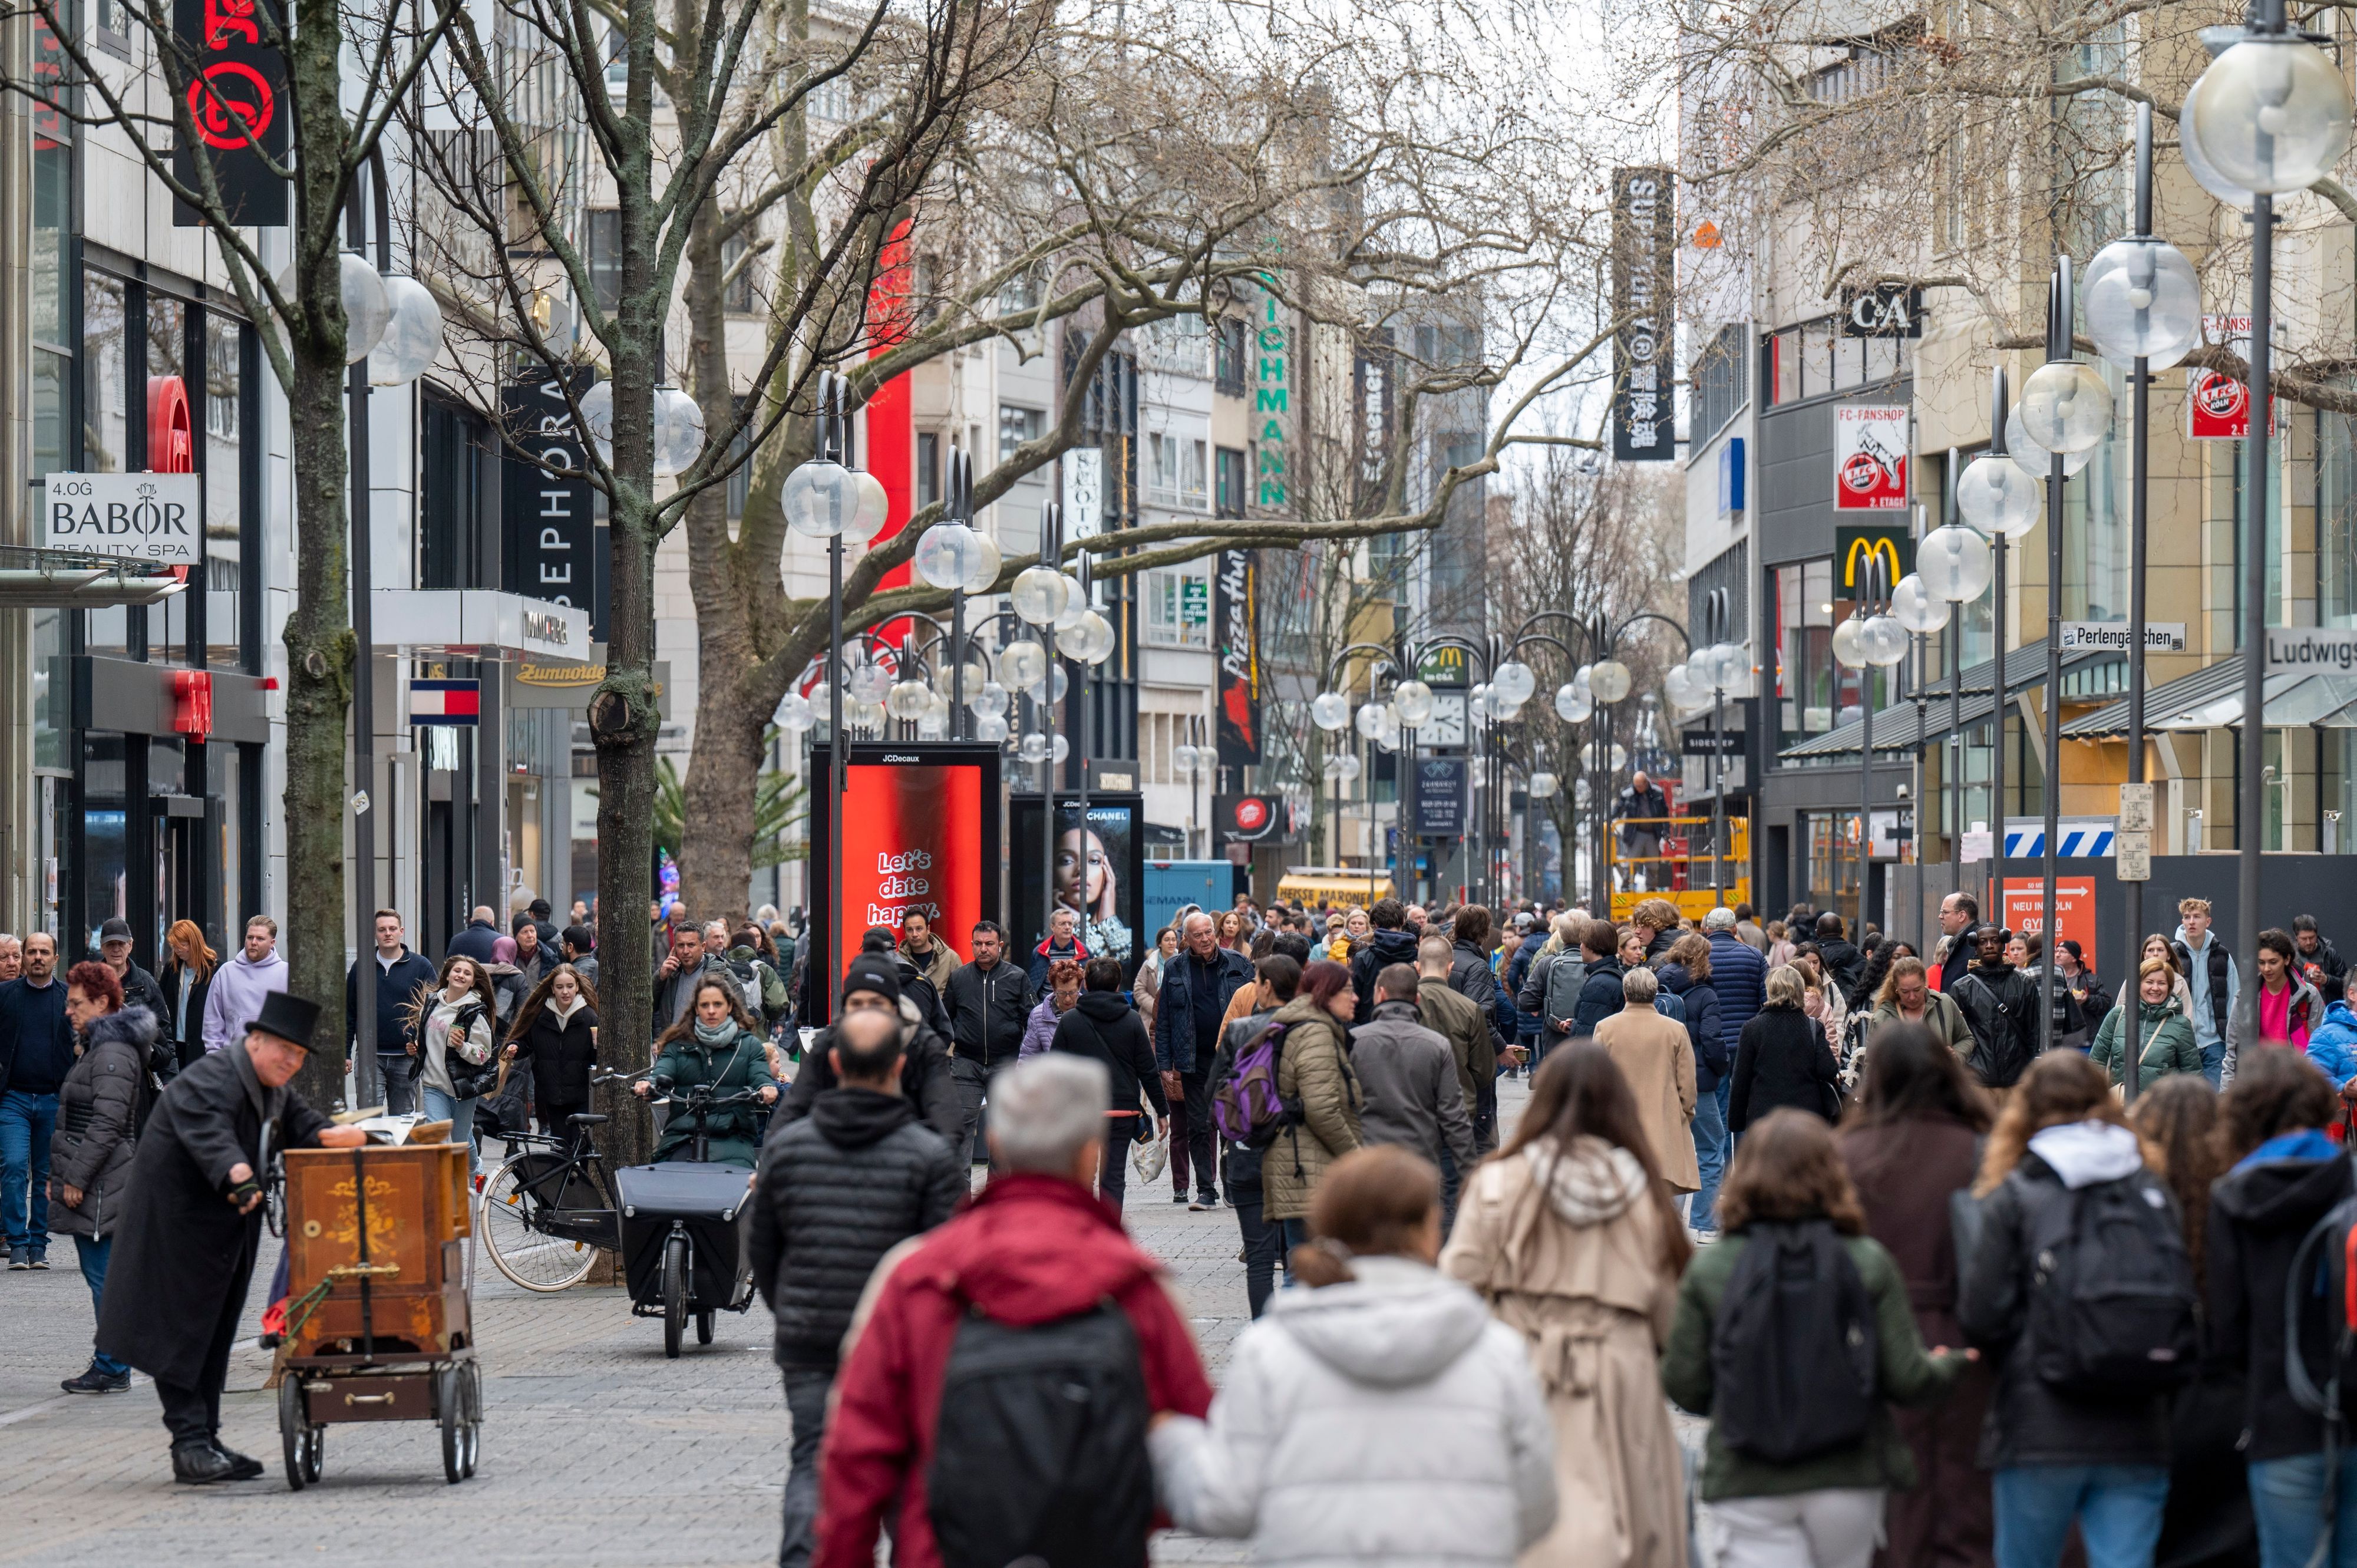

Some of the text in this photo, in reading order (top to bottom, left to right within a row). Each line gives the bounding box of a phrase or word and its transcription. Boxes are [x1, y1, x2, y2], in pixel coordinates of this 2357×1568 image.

[1851, 295, 1912, 328] C&A
[2210, 398, 2230, 410] KÖLN
[1840, 409, 1904, 421] FC-FANSHOP
[1880, 497, 1905, 508] ETAGE
[53, 502, 190, 536] BABOR
[148, 544, 189, 556] SPA
[1222, 603, 1250, 681] Pizza
[2078, 627, 2171, 649] Perlengächen
[2269, 636, 2357, 669] Ludwig
[516, 663, 606, 681] Zumnorde
[1689, 738, 1735, 747] SIDESEP
[1087, 812, 1127, 821] CHANEL
[878, 849, 932, 874] Let's
[879, 876, 929, 899] date
[1280, 887, 1314, 900] HEISSE
[2013, 900, 2072, 911] NEU IN ÖLN
[867, 902, 940, 928] hapy.
